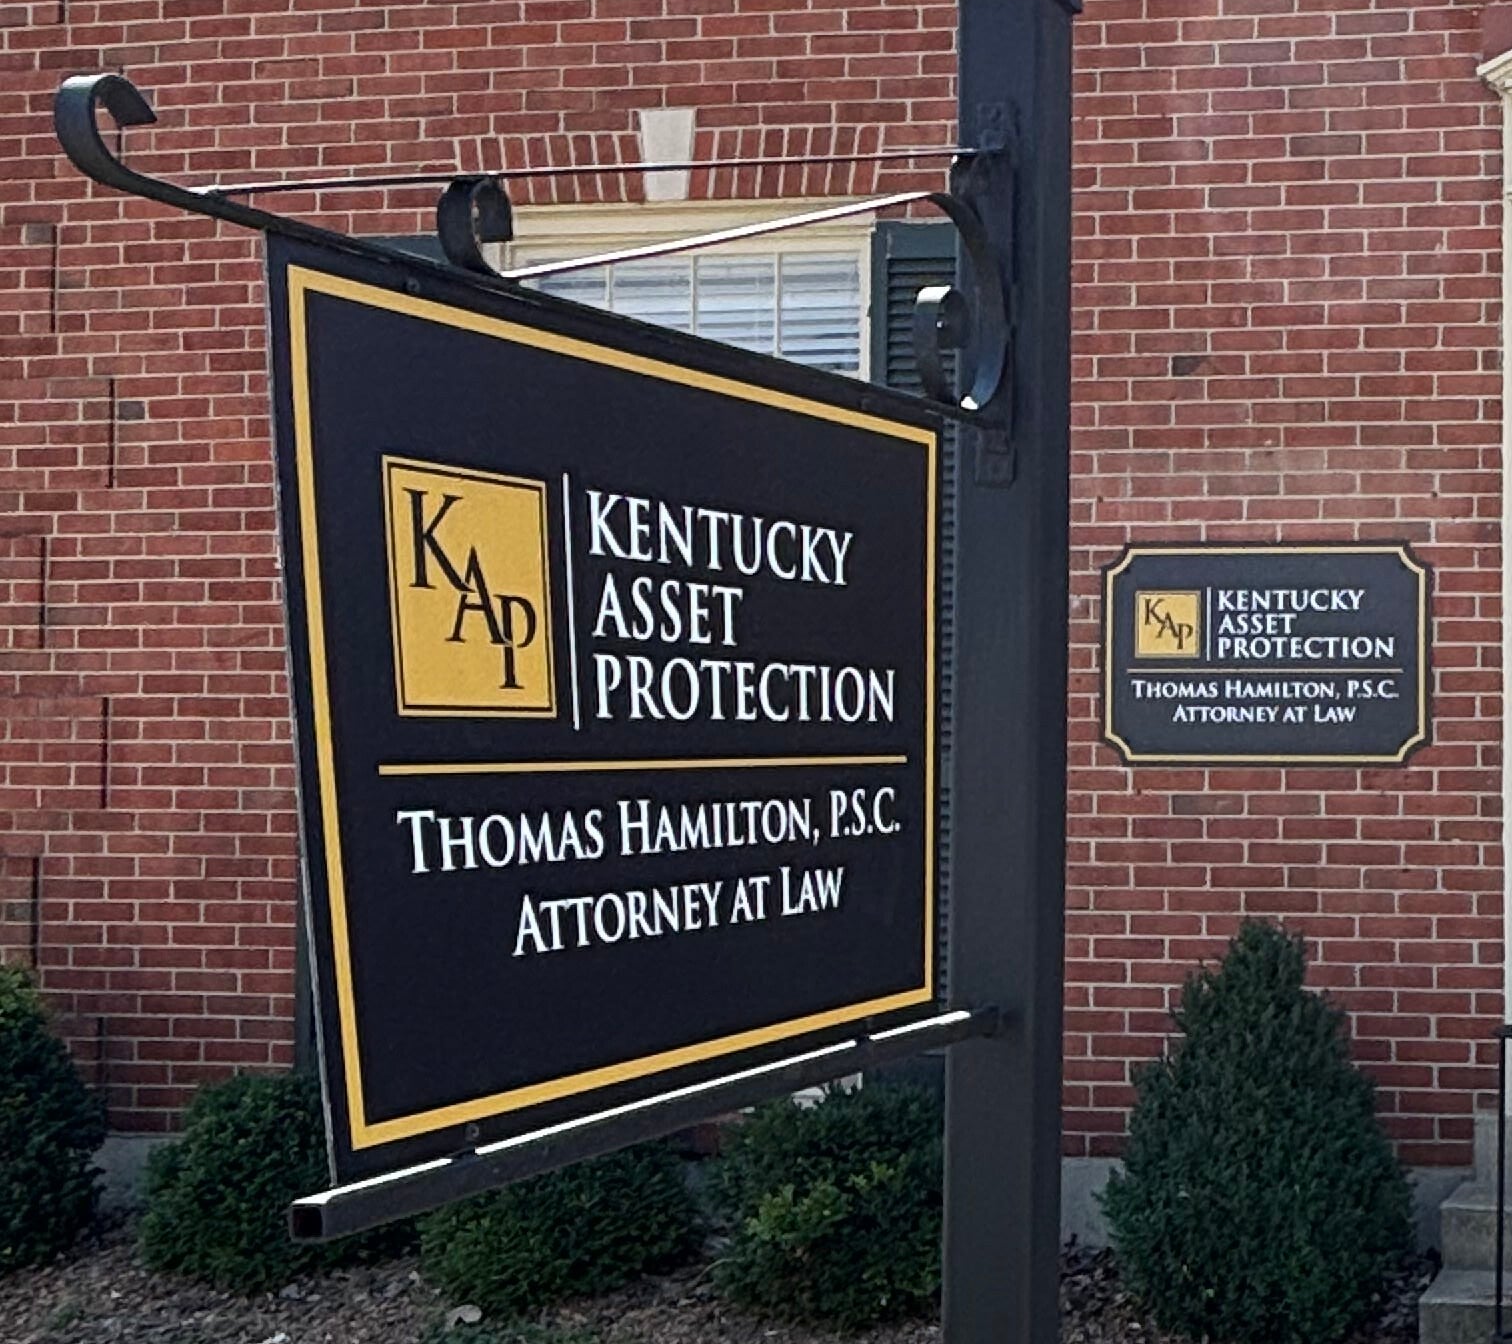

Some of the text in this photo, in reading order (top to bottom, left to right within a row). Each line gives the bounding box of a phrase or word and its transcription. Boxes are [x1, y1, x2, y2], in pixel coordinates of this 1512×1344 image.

[585, 489, 853, 586] KENTUCKY
[592, 573, 743, 645] ASSET
[1218, 589, 1364, 611] KENTUCKY
[1218, 613, 1297, 635] ASSET
[1218, 636, 1394, 659] PROTECTION
[593, 654, 896, 723] PROTECTION
[1131, 679, 1399, 700] THOMAS HAMILTON, P.S.C.
[1172, 704, 1357, 723] ATTORNEY AT LAW
[396, 786, 901, 874] THOMAS HAMILTON, P.S.C.
[512, 866, 844, 956] ATTORNEY AT LAW
